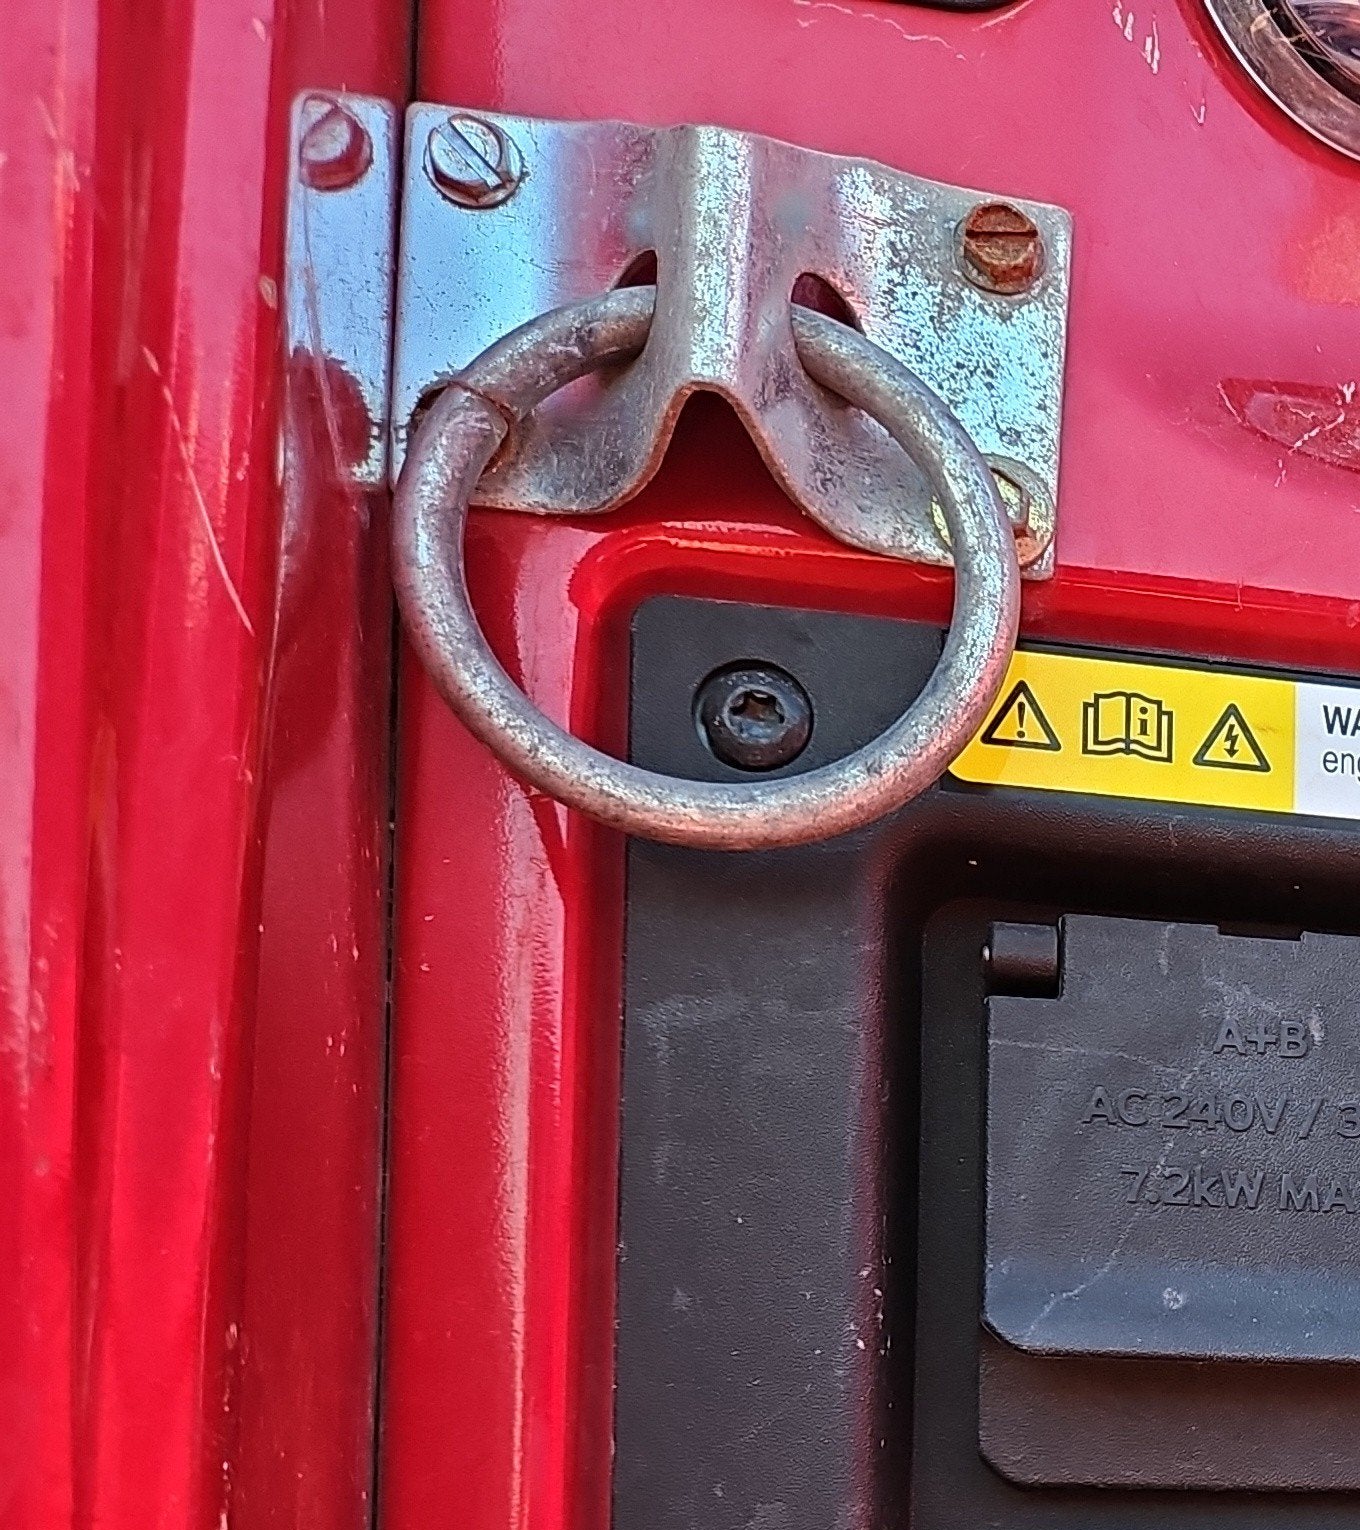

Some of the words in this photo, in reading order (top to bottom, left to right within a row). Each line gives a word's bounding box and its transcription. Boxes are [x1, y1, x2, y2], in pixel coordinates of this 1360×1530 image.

[1212, 1020, 1311, 1058] A+B
[1081, 1086, 1148, 1128] AC
[1162, 1092, 1288, 1135] 240V
[1300, 1097, 1325, 1140] /
[1121, 1165, 1265, 1210] 7.2kW
